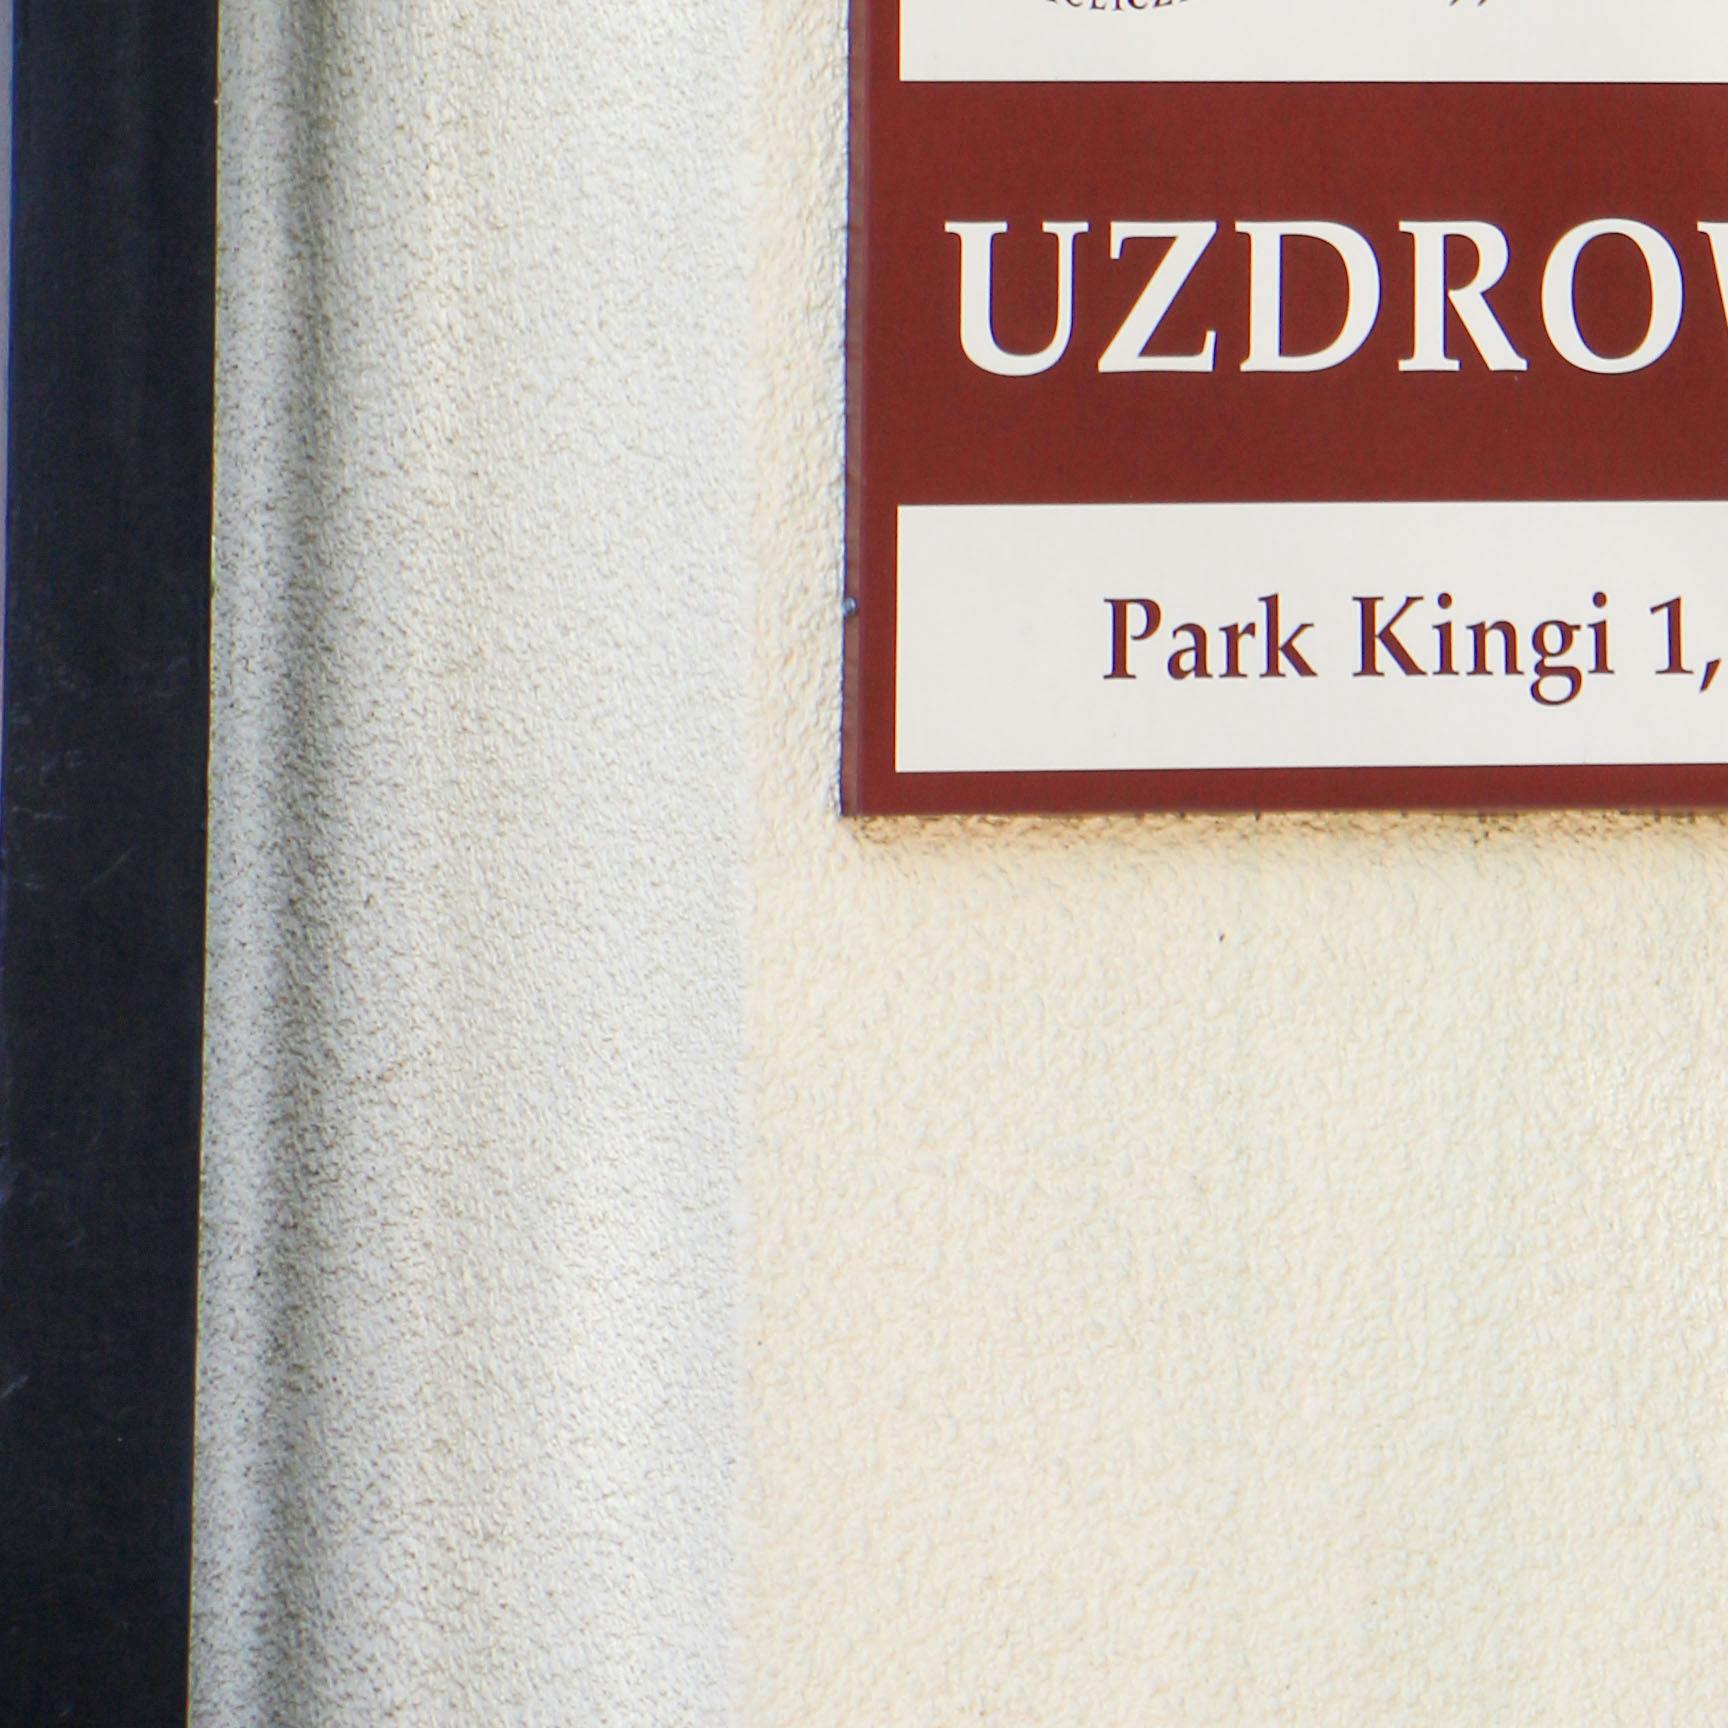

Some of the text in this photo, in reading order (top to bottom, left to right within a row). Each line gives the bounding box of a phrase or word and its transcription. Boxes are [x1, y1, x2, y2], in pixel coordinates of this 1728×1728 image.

[1103, 593, 1318, 680] Park
[1352, 592, 1614, 706] Kingi
[1650, 596, 1721, 692] 1,
